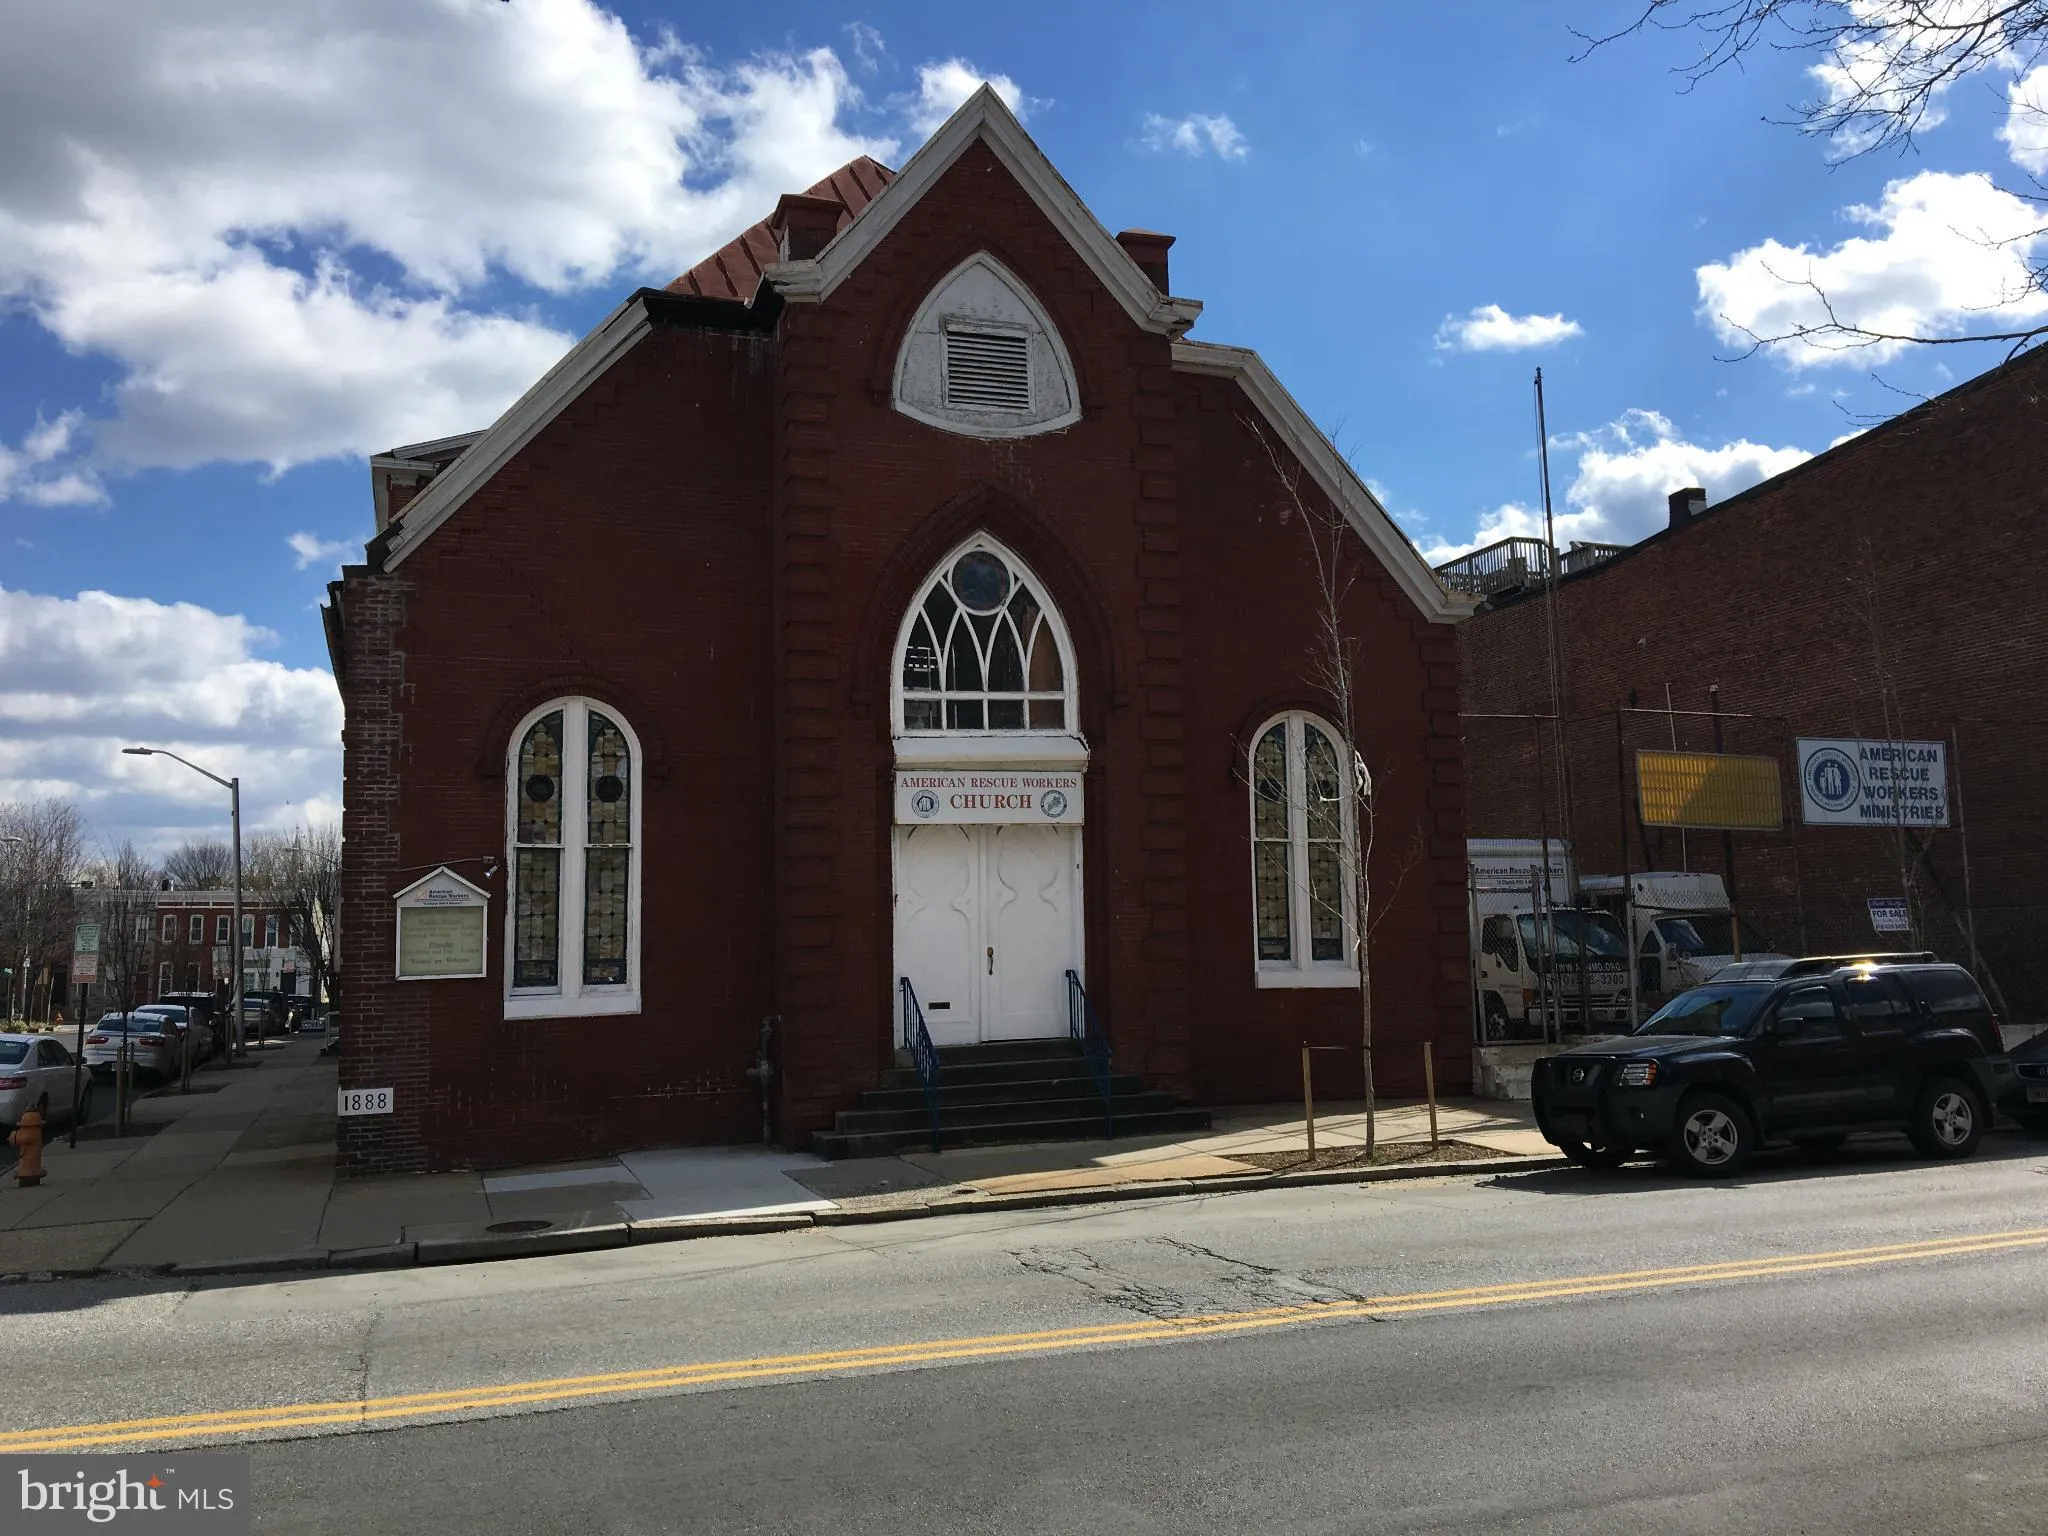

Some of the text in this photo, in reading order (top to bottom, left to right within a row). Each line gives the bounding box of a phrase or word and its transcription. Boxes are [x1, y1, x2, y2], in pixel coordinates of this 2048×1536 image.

[1860, 747, 1937, 762] AMERICAN
[1869, 766, 1929, 781] RESCUE
[901, 777, 1077, 788] AMERICAN RESCUE WORKERS
[1863, 785, 1938, 800] WORKERS
[950, 794, 1032, 809] CHURCH
[1860, 804, 1944, 819] MINISTRIES
[1475, 867, 1508, 875] American
[1509, 867, 1531, 875] Rescu
[1872, 909, 1907, 918] FOR SALE
[344, 1093, 386, 1111] 1888
